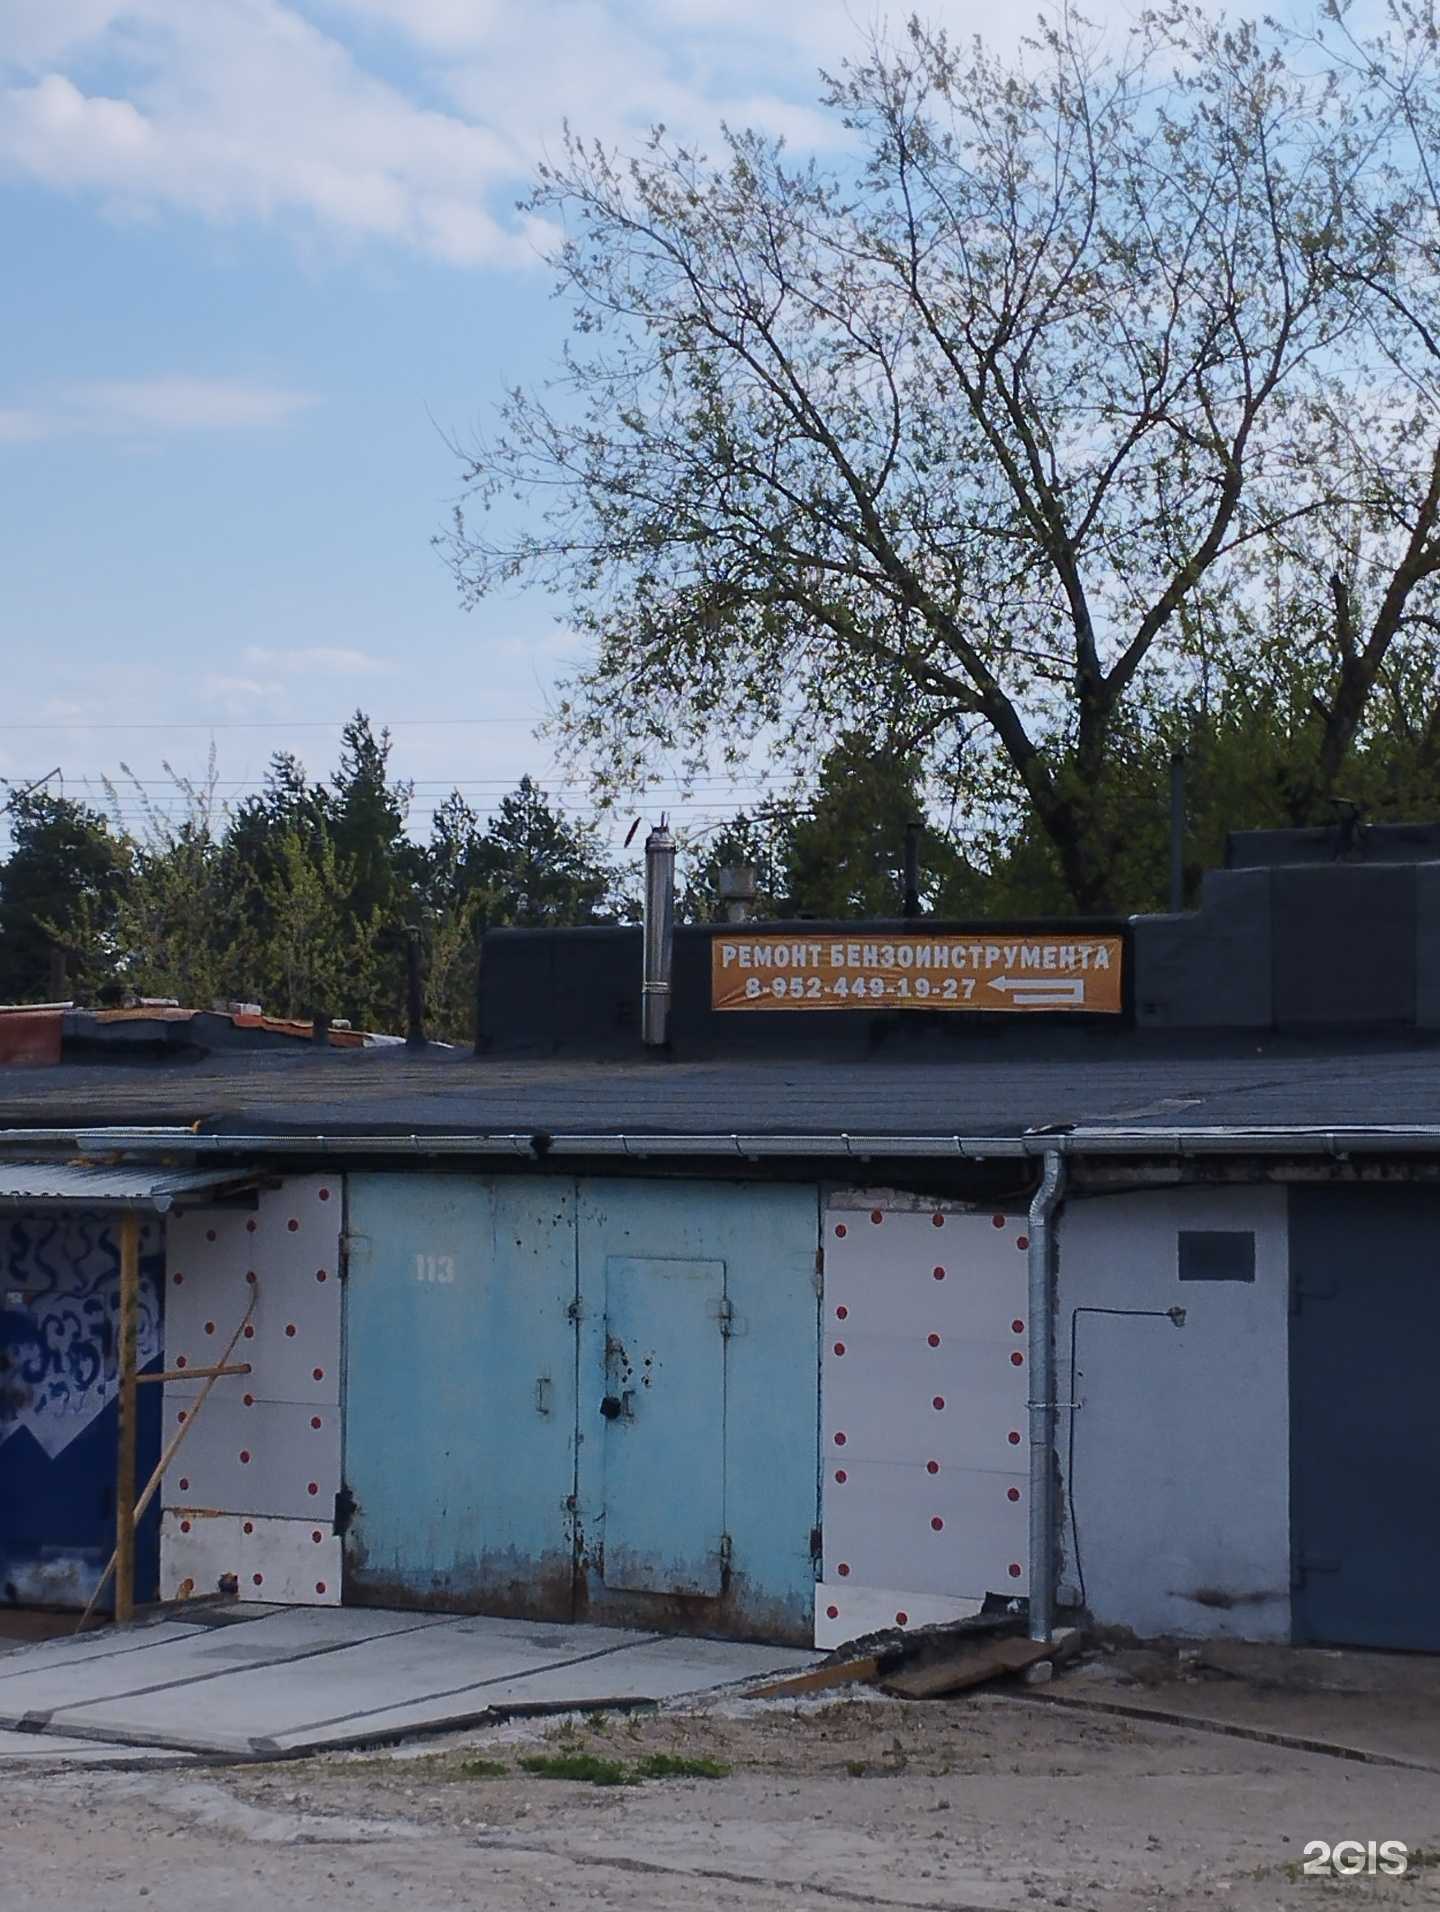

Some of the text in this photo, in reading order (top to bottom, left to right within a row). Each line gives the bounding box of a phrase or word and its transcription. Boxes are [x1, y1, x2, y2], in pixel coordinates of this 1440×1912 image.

[721, 944, 1111, 969] РЕМОНТ БЕНЗОИНСТРУМЕНТА
[745, 976, 977, 998] 8-952-449-19-27
[415, 1254, 455, 1283] 113
